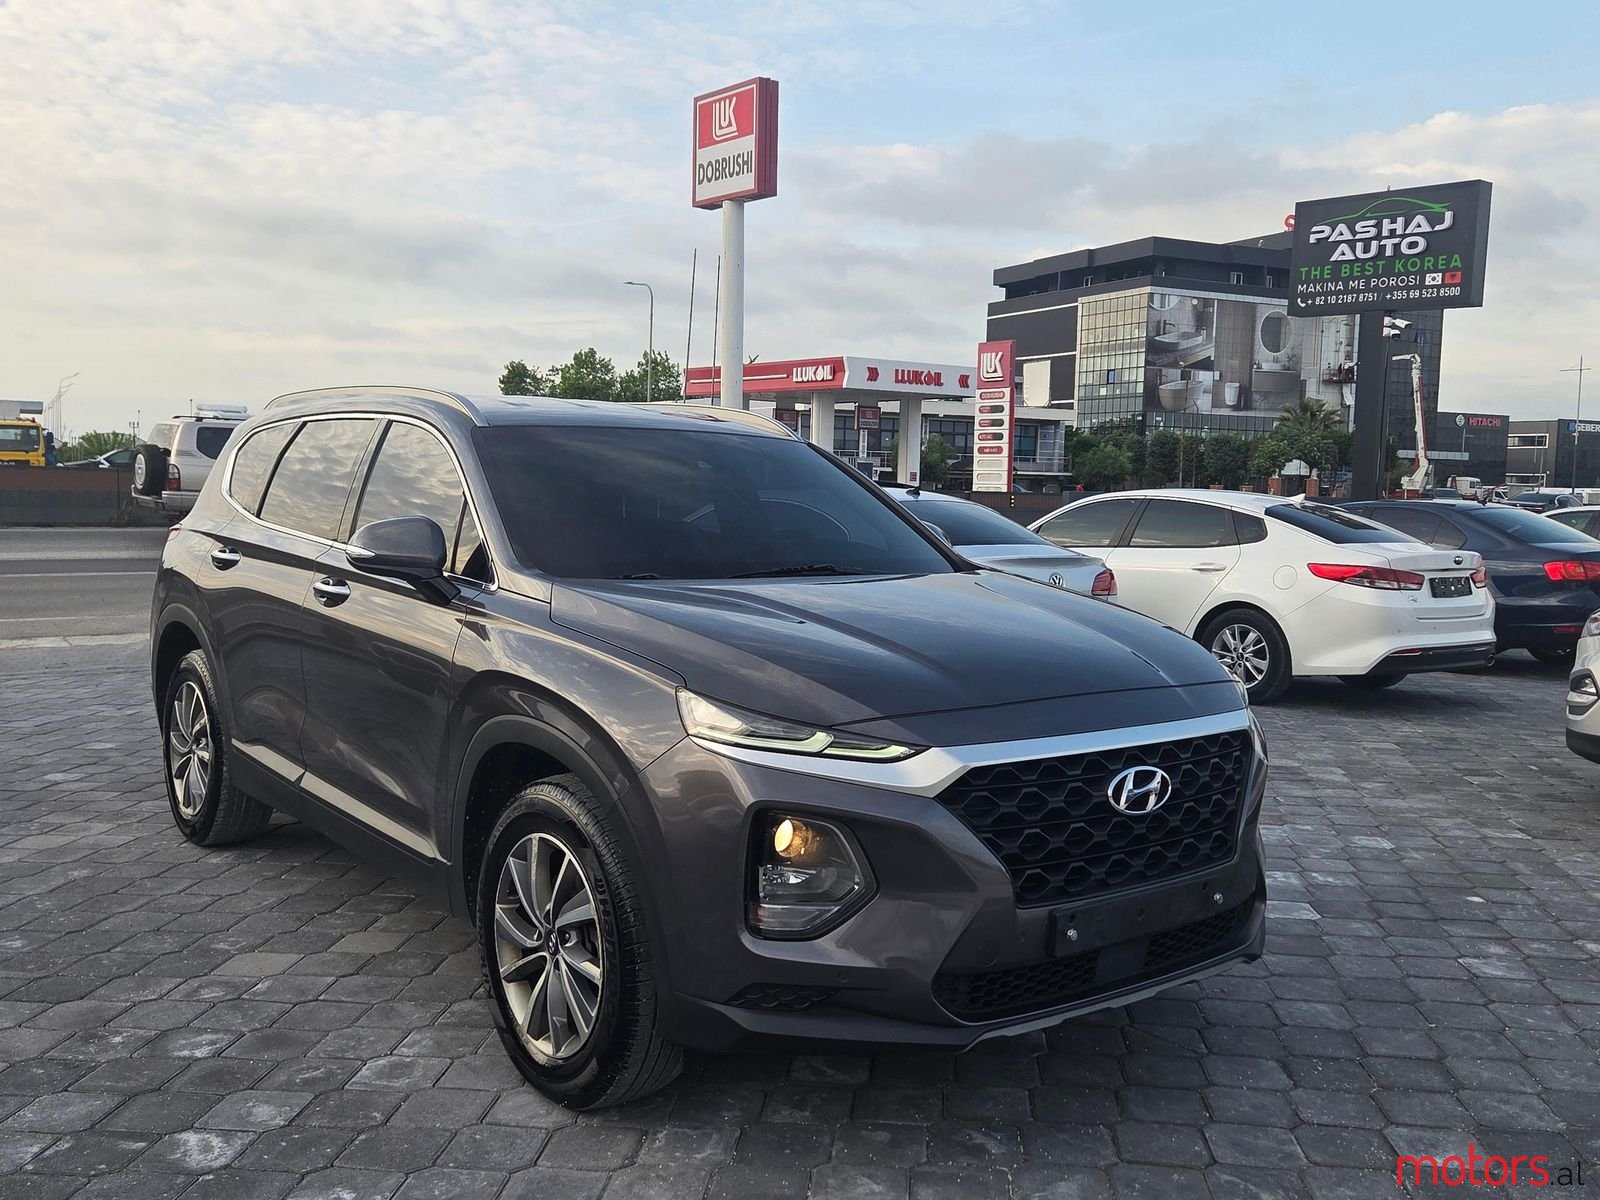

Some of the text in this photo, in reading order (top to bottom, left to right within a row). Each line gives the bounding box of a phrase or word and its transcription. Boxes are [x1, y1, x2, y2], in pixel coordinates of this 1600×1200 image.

[697, 150, 753, 185] DOBRUSHI
[1309, 210, 1454, 243] PASHAJ
[1330, 235, 1427, 261] AUTO
[1300, 254, 1462, 280] THE BEST KOREA
[1297, 275, 1420, 294] MAKINA ME POROSI
[1327, 295, 1336, 304] 10
[1338, 294, 1357, 303] 2187
[1359, 292, 1377, 302] 8751
[1386, 290, 1407, 300] +355
[1409, 289, 1420, 298] 69
[1422, 288, 1437, 298] 523
[1439, 286, 1461, 297] 8500
[1469, 416, 1501, 427] HITACHI
